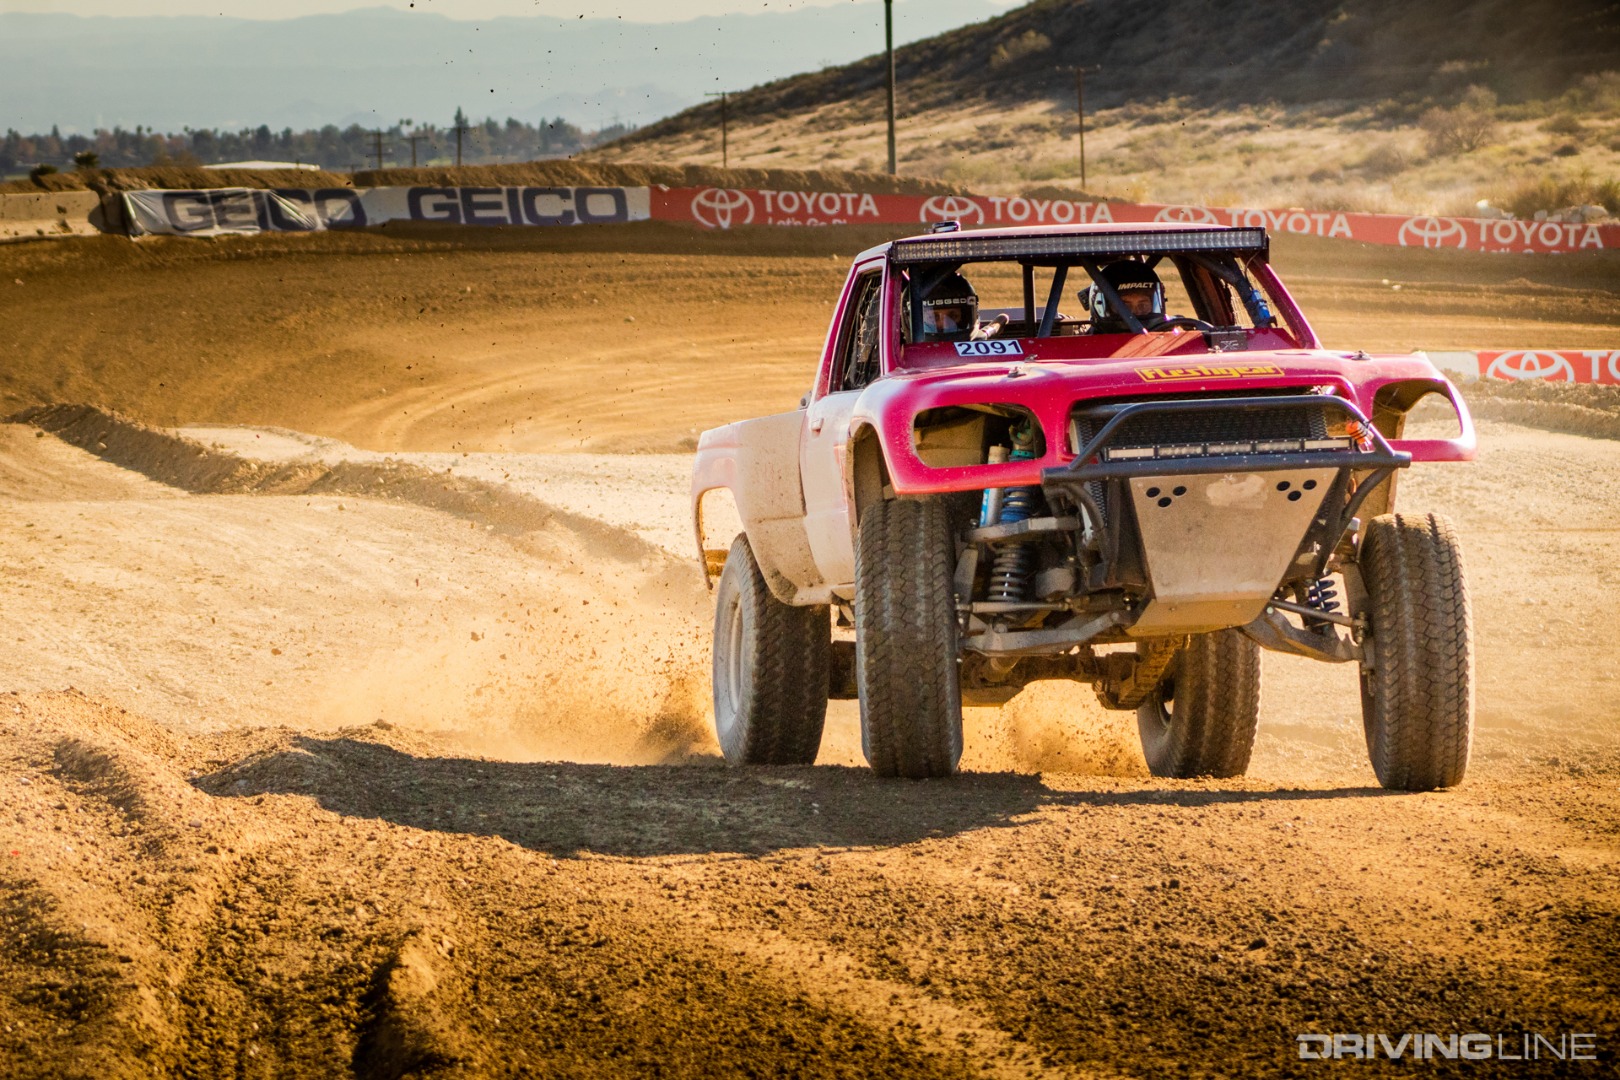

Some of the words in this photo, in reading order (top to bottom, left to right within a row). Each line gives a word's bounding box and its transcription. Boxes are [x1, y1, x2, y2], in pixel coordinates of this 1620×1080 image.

[162, 188, 367, 231] GEICO
[407, 186, 628, 226] GEICO
[758, 190, 880, 217] TOYOTA
[988, 197, 1114, 223] TOYOTA
[1225, 208, 1353, 238] TOYOTA
[1473, 219, 1604, 249] TOYOTA
[1118, 282, 1154, 291] IMPACT
[957, 341, 1022, 355] 2091
